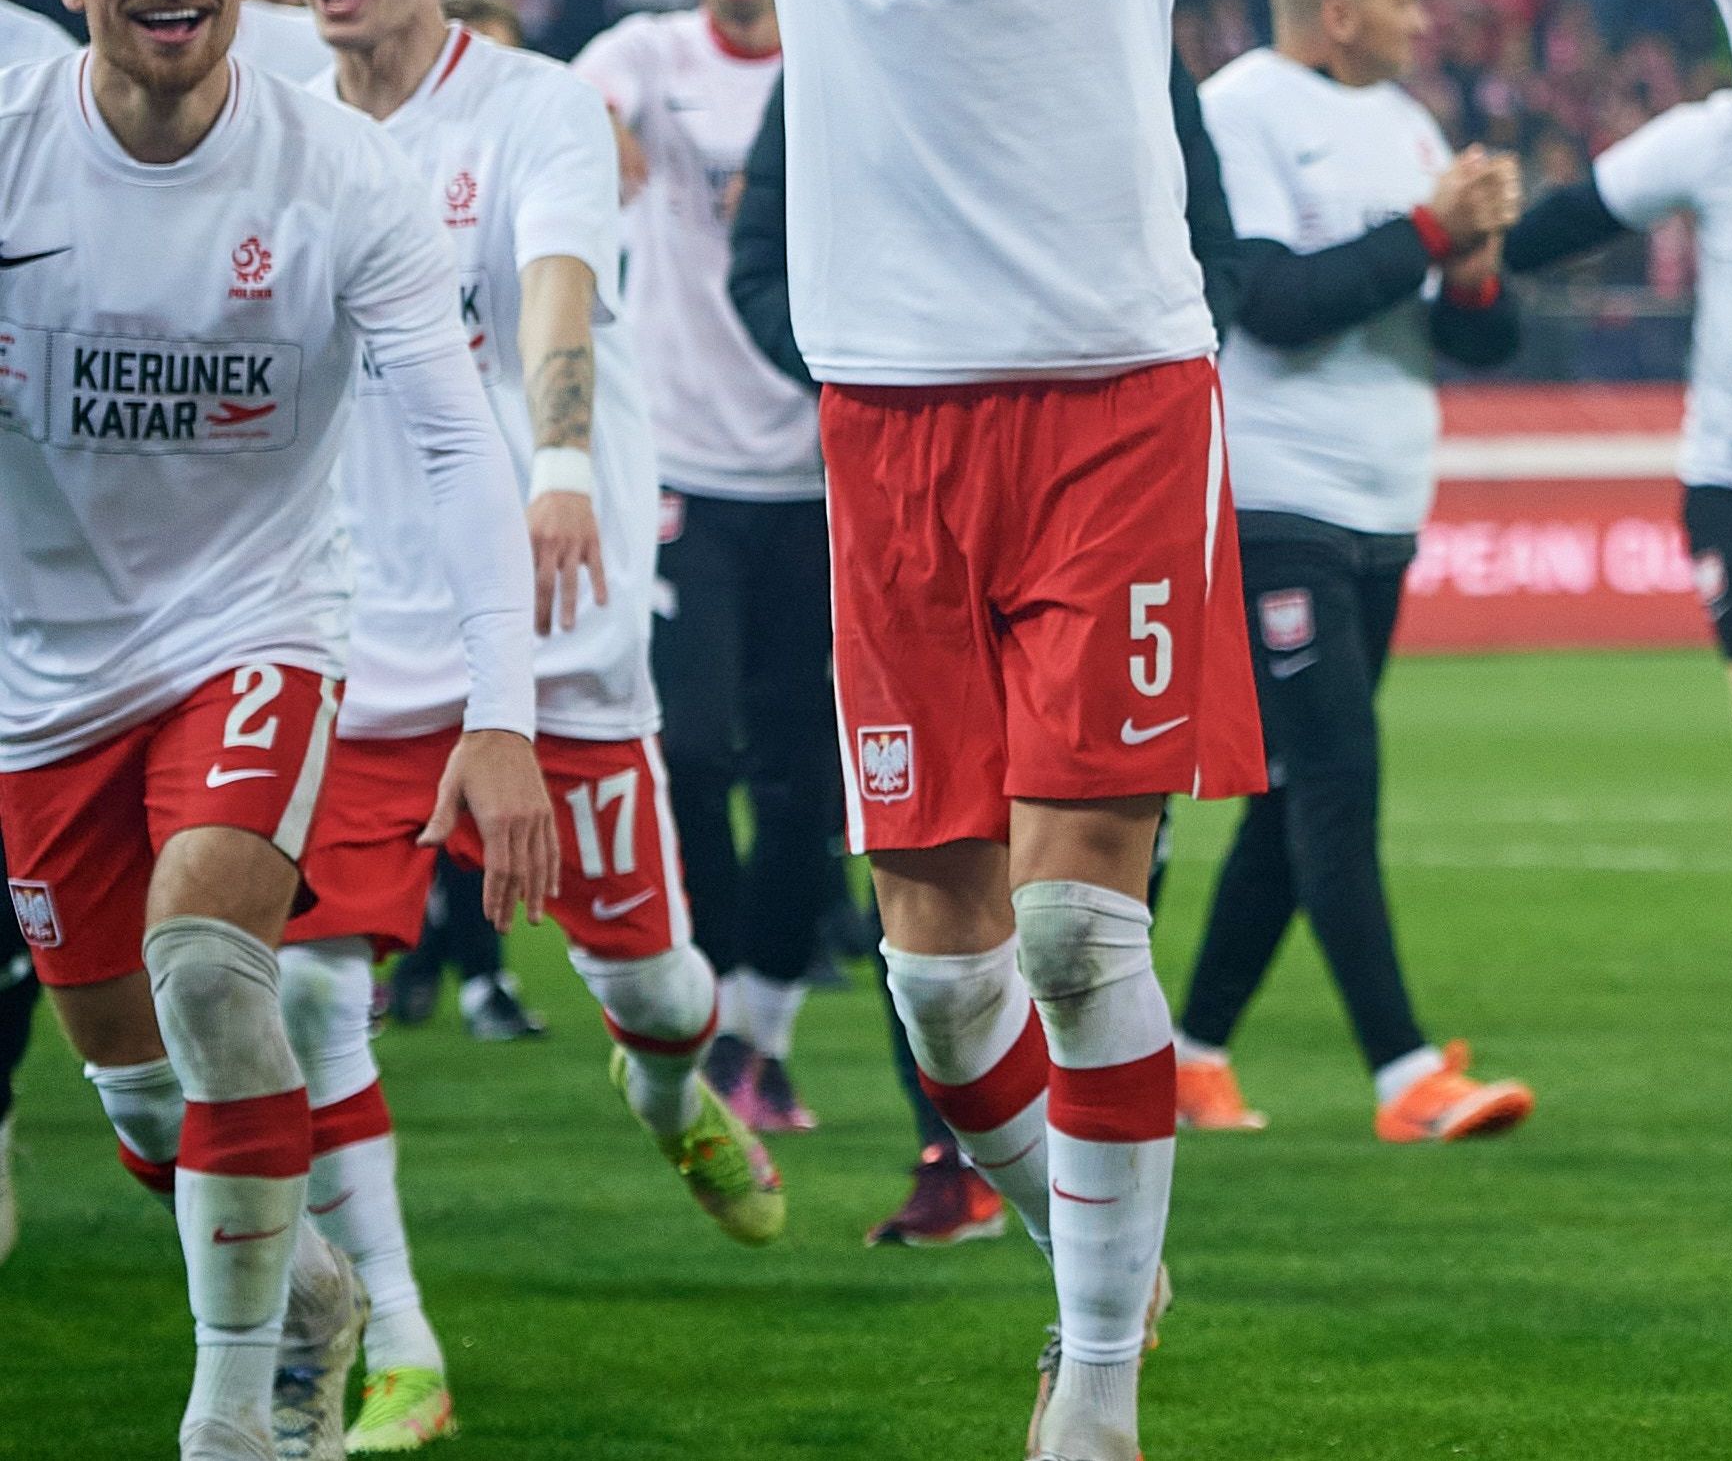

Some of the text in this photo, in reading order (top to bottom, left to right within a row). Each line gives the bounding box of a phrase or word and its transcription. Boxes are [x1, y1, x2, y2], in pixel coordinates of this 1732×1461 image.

[72, 348, 273, 396] KIERUNEK
[71, 397, 198, 439] KATAR
[1129, 578, 1173, 696] 5
[223, 663, 283, 749] 2
[565, 767, 639, 879] 17
